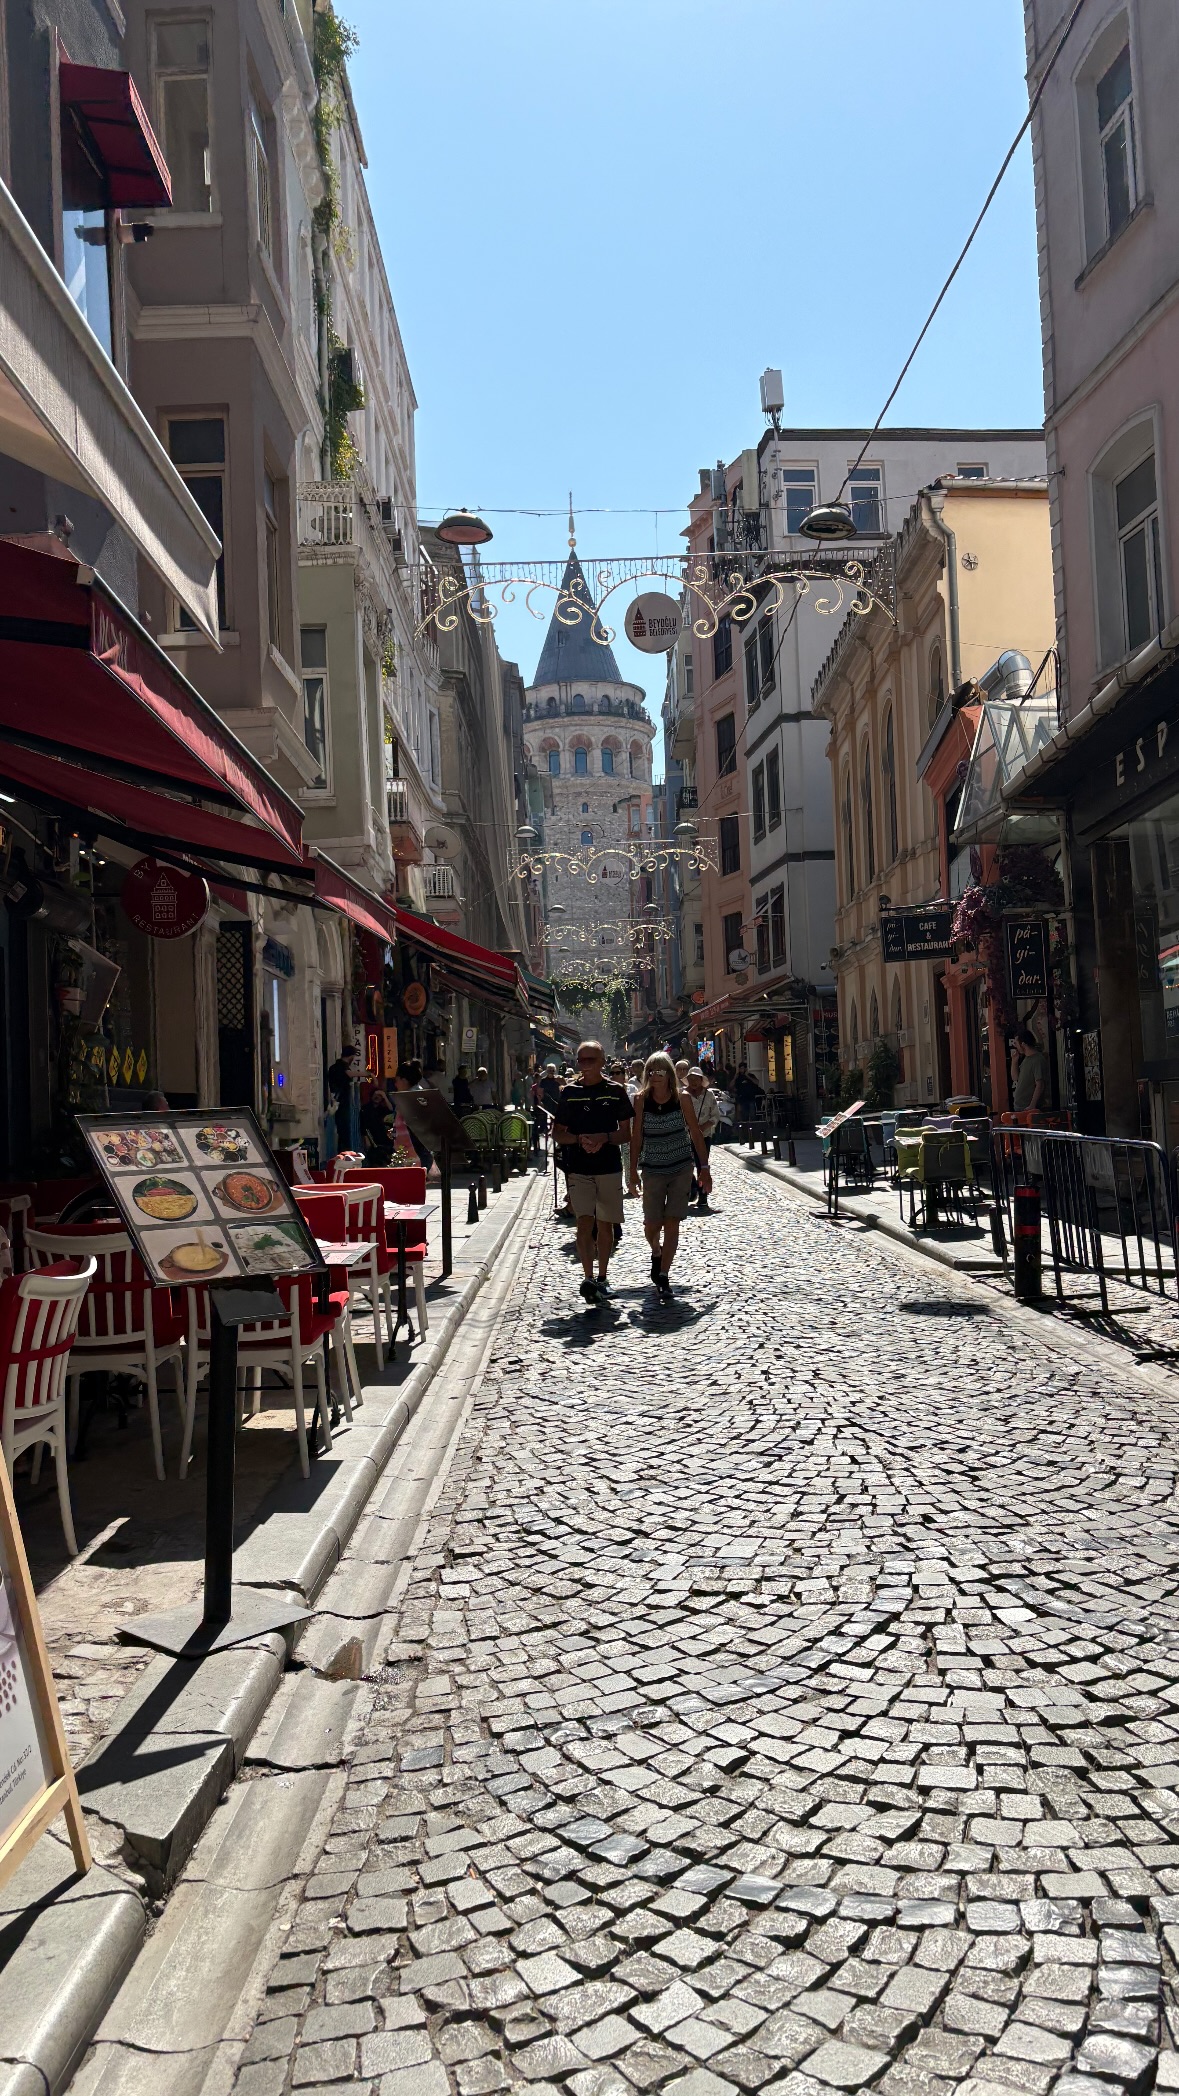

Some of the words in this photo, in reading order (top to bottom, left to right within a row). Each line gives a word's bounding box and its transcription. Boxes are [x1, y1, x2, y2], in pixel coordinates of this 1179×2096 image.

[648, 616, 677, 628] BEYOĞLU
[133, 861, 151, 879] BY
[132, 913, 199, 936] RESTAURANT
[919, 921, 937, 931] CAFE
[925, 932, 932, 940] &
